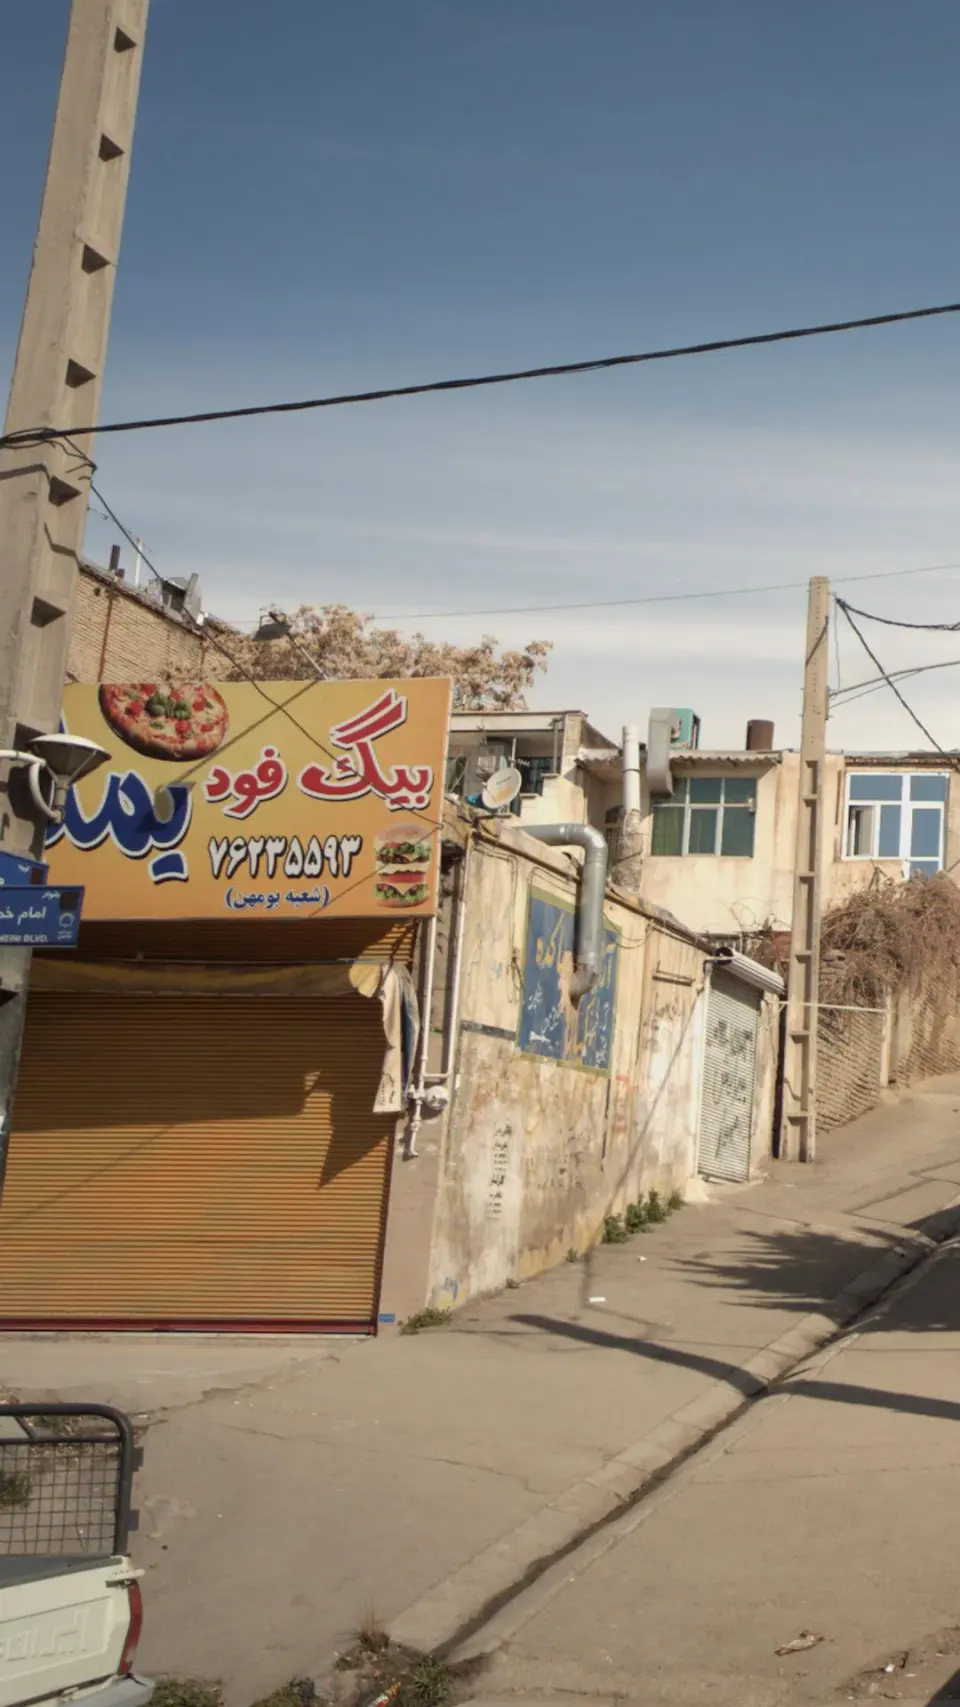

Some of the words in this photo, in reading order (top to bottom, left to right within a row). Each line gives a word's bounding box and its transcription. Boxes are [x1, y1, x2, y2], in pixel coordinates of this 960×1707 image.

[298, 688, 433, 809] بیگ
[203, 746, 287, 818] فود
[208, 834, 363, 879] ۷۶۲۳۵۵۹۳
[17, 905, 47, 926] امام
[285, 886, 330, 908] (شعبه
